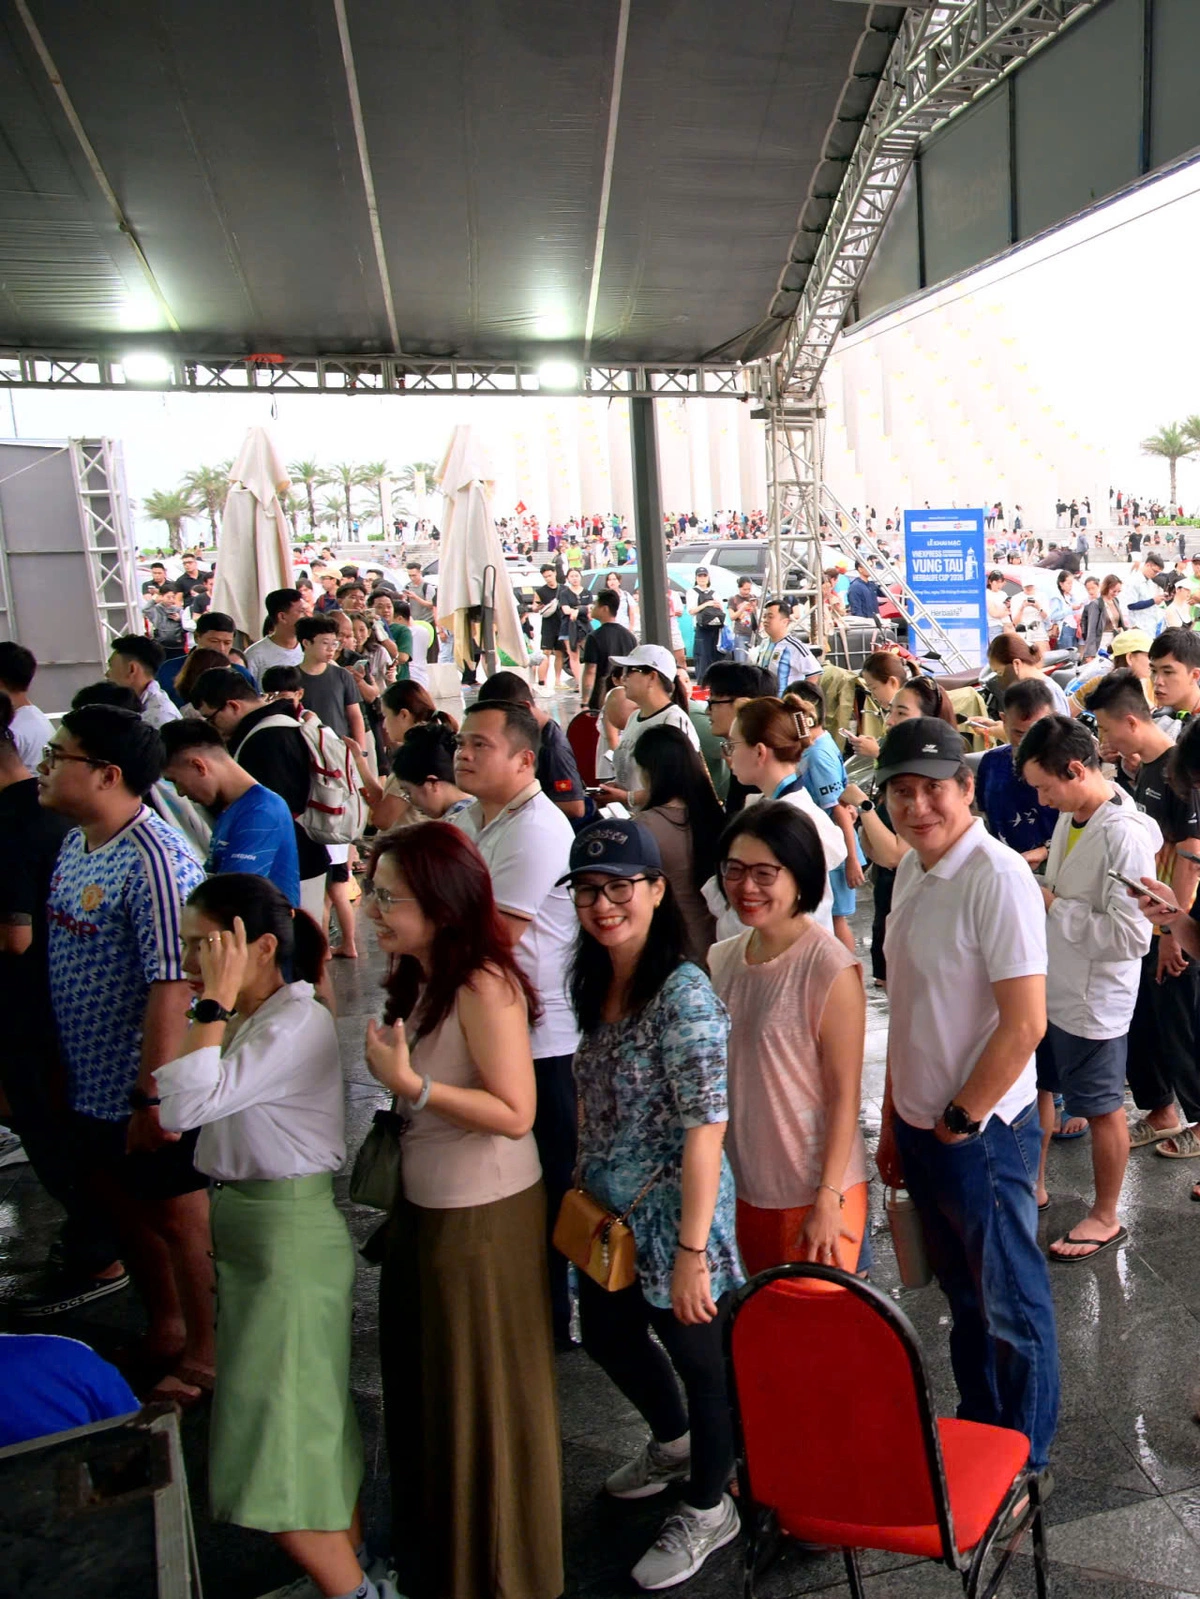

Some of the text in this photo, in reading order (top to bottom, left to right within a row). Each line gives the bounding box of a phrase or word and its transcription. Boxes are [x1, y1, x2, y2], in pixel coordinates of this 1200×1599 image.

[912, 558, 964, 573] VUNG TAU
[41, 1295, 86, 1314] crocs
